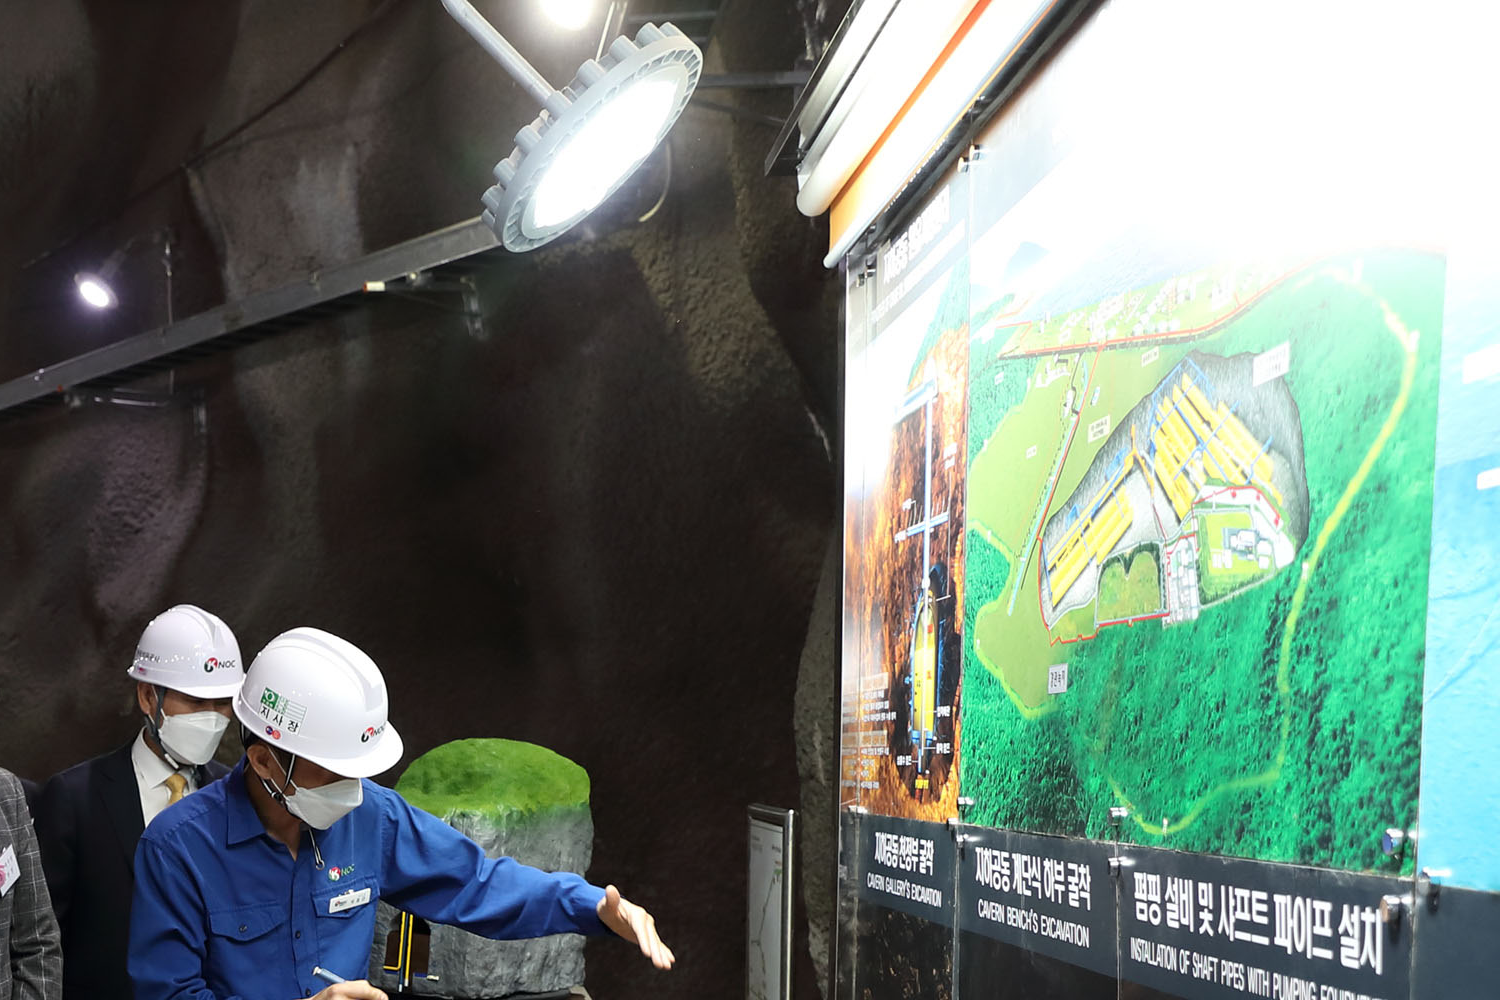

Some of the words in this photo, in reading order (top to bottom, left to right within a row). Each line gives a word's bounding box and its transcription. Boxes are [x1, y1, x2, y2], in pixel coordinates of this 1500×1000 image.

[204, 657, 236, 673] KNOC
[874, 831, 899, 868] 지하공동
[919, 839, 935, 876] 굴착
[975, 846, 1011, 893] 지하공동
[1011, 853, 1042, 900] 계단식
[1043, 857, 1066, 905] 하부
[1067, 862, 1092, 911] 굴착
[867, 872, 885, 892] CAVERN
[885, 877, 911, 899] GALLERY'S
[911, 883, 942, 908] EXCAVATION
[977, 898, 1005, 924] CAVERN
[1006, 905, 1039, 934] BENCH'S
[1040, 914, 1090, 949] EXCAVATION
[1133, 871, 1162, 926] 펌핑
[1164, 876, 1194, 933] 설비
[1198, 881, 1214, 937] 및
[1217, 884, 1270, 946] 샤프트
[1273, 893, 1334, 960] 파이프
[1338, 903, 1384, 976] 설치
[1130, 936, 1177, 972] INSTALLATION
[1179, 948, 1191, 975] OF
[1192, 951, 1219, 983] SHAFT
[1220, 959, 1245, 992] PIPES
[1246, 965, 1270, 999] WITH
